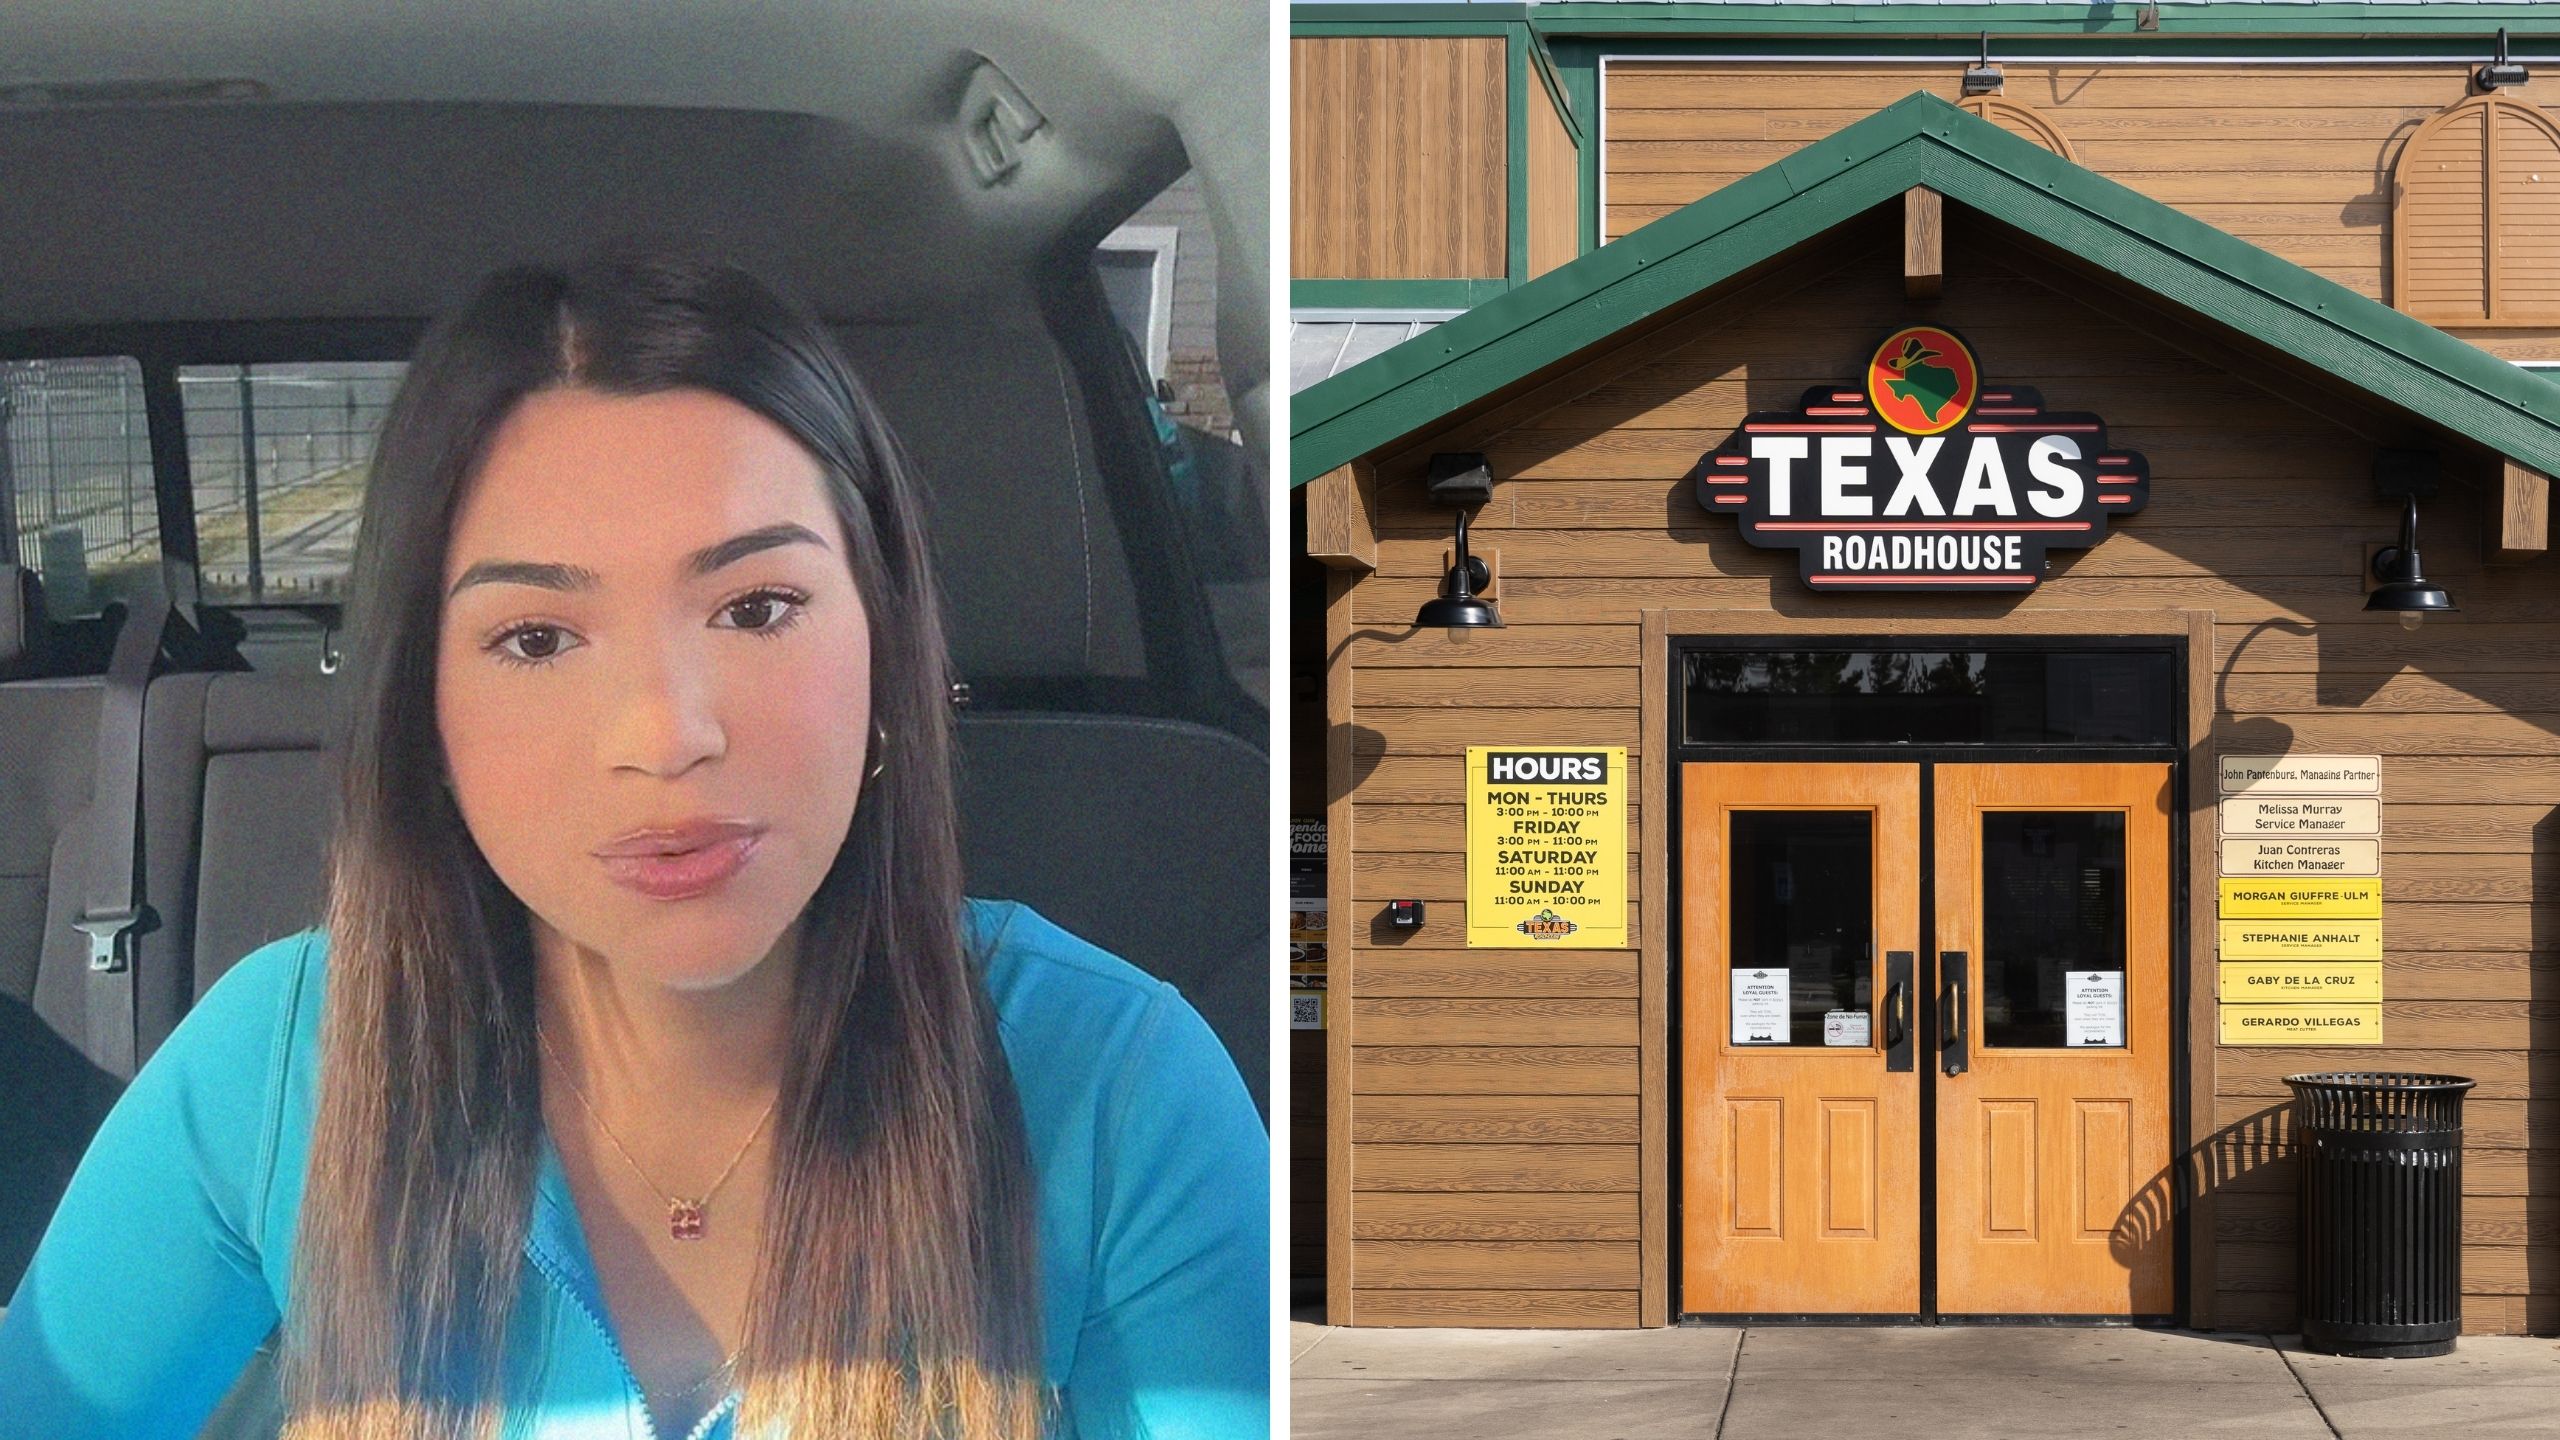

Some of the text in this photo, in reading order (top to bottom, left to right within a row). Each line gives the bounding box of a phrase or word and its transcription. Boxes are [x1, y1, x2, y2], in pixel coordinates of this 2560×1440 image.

[1751, 434, 2084, 518] TEXAS
[1823, 535, 2021, 570] ROADHOUSE
[1493, 757, 1601, 780] HOURS
[2224, 770, 2375, 780] John Pantenburg, Managing Partner
[1488, 792, 1529, 805] MON
[1547, 792, 1607, 805] THURS
[1497, 808, 1524, 816] 3:00
[1552, 808, 1584, 816] 10:00
[2259, 804, 2342, 815] Melissa Murray
[1514, 821, 1580, 834] FRIDAY
[2256, 819, 2345, 829] Service Manager
[1497, 837, 1524, 845] 3:00
[1553, 837, 1582, 845] 11:00
[2258, 845, 2340, 855] Juan Contreras
[1498, 851, 1597, 864] SATURDAY
[2254, 860, 2345, 870] Kitchen Manager
[1496, 867, 1524, 876] 11:00
[1554, 867, 1583, 876] 11:00
[1510, 881, 1584, 894] SUNDAY
[1495, 896, 1524, 905] 11:00
[1553, 896, 1585, 905] 10:00
[2234, 892, 2368, 900] MORGAN GIUFFRE-ULM
[1526, 922, 1569, 933] TEXAS
[2242, 934, 2360, 942] STEPHANIE ANHALT
[2248, 977, 2280, 985] GABY
[2325, 977, 2355, 985] CRUZ
[2242, 1018, 2360, 1026] GERARDO VILLEGAS
